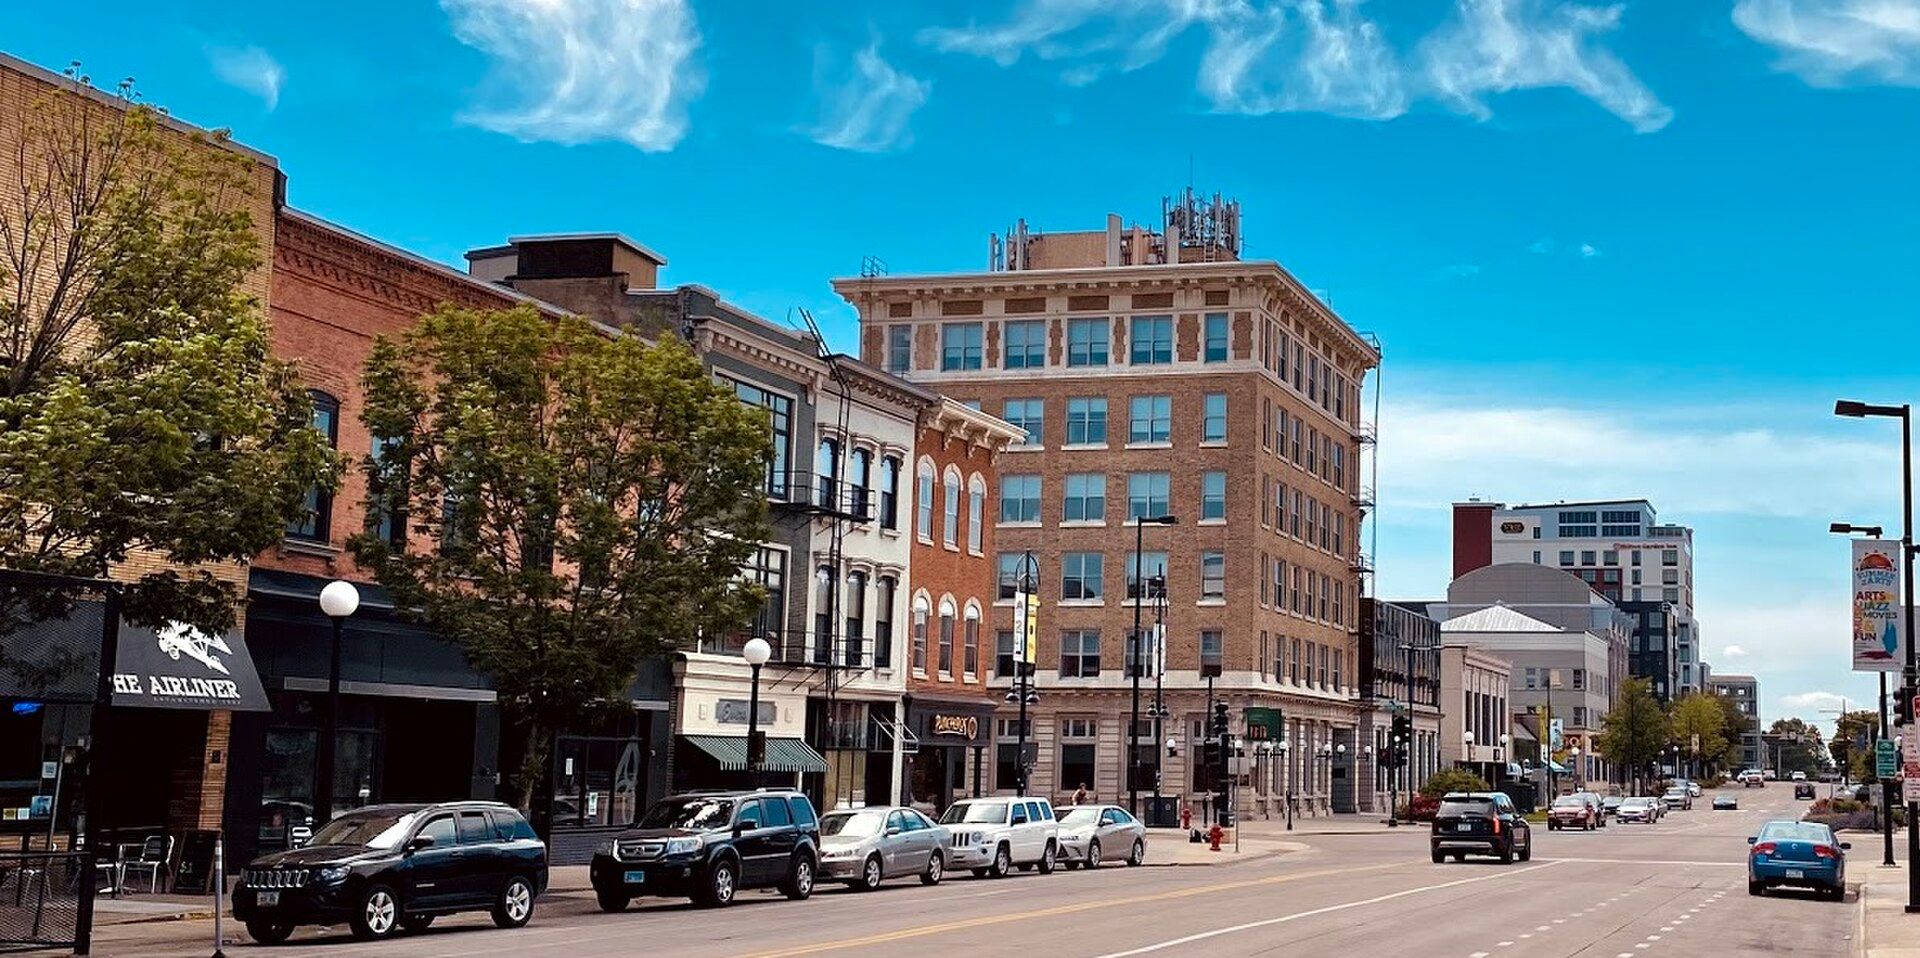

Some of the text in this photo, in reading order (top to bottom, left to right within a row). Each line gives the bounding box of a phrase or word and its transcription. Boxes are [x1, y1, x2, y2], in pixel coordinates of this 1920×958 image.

[1856, 591, 1886, 601] ARTS
[1854, 632, 1877, 641] FUN
[112, 673, 241, 699] HE AIRLINER
